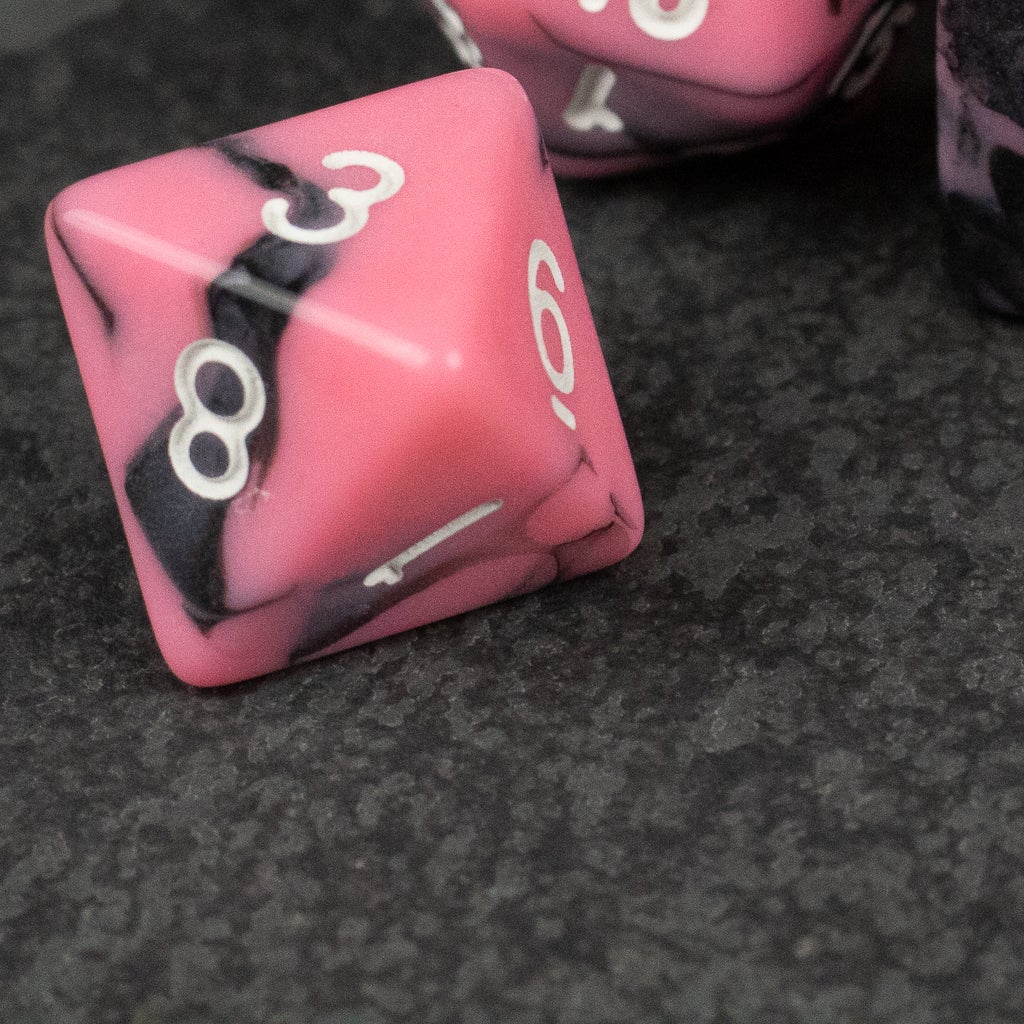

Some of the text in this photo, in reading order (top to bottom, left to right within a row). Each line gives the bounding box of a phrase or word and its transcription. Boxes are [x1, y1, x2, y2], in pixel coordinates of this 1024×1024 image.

[261, 150, 405, 245] 3
[167, 337, 267, 501] 8
[363, 498, 504, 587] 1
